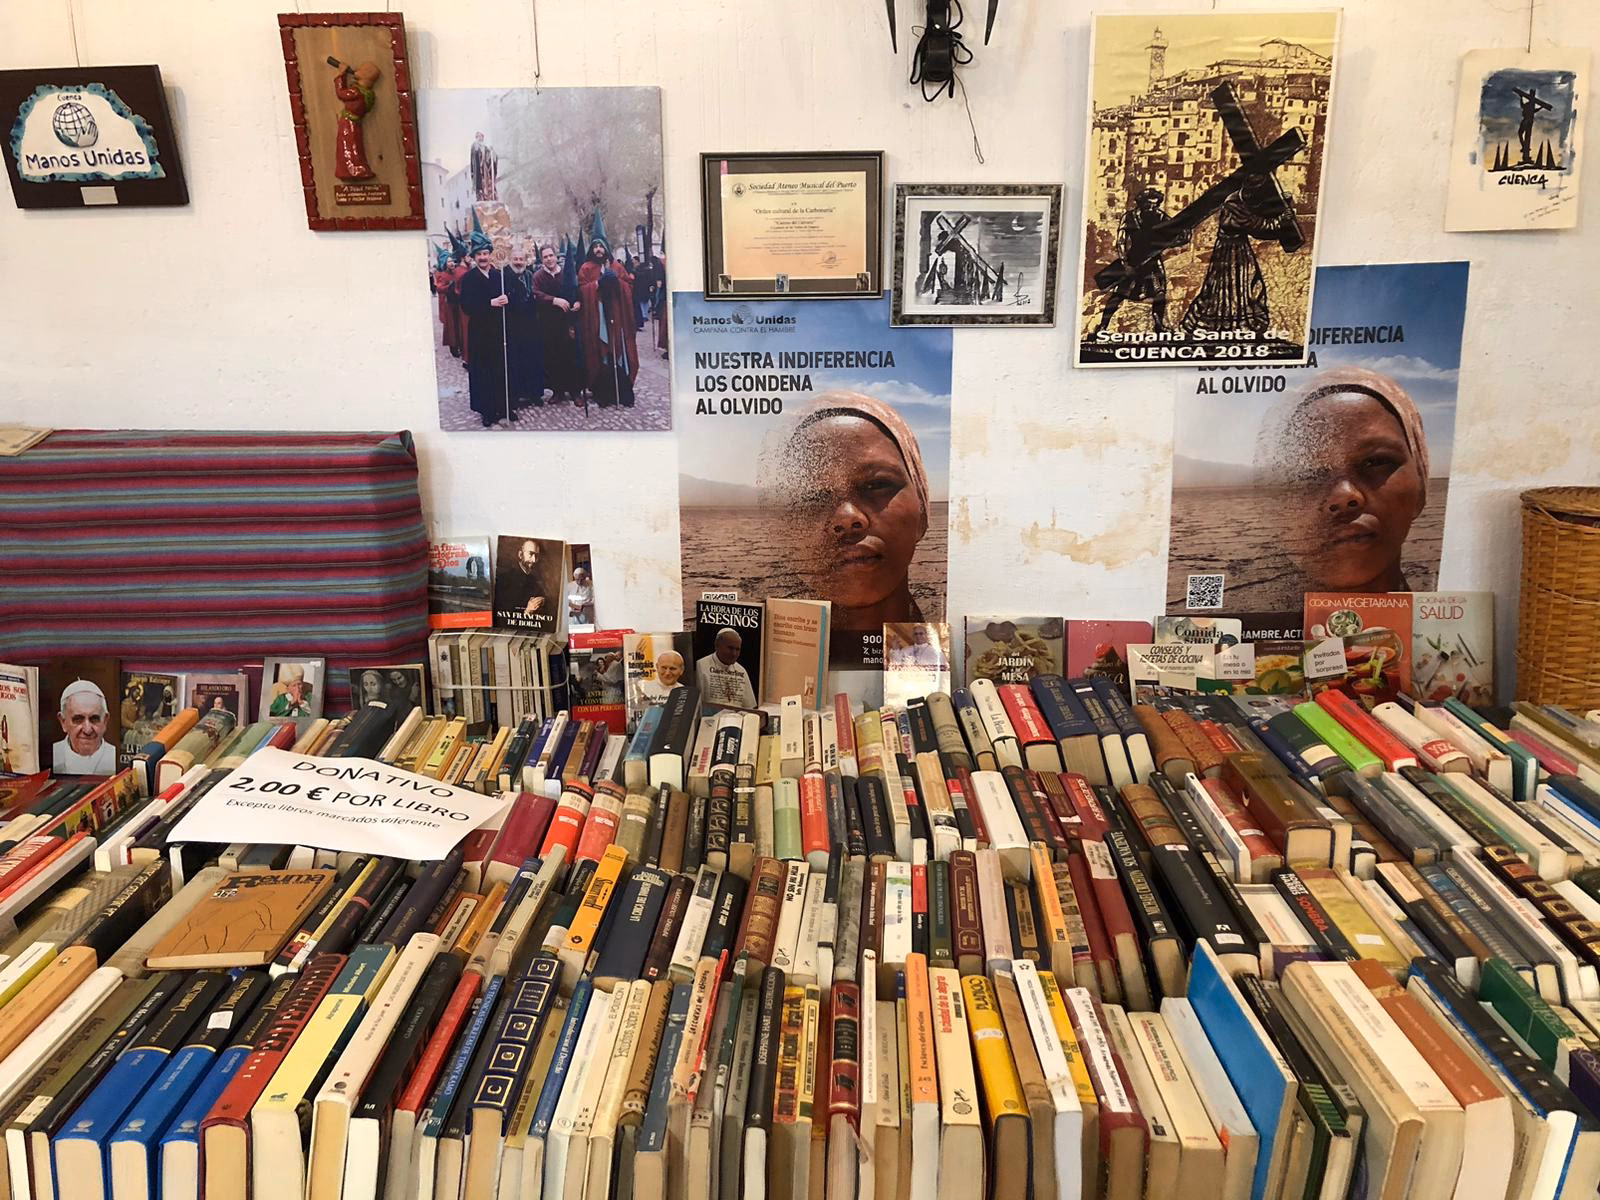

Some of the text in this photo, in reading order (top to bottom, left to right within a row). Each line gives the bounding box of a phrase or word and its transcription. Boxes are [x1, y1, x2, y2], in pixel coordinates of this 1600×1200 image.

[58, 94, 82, 102] Cuenca
[26, 148, 144, 171] Manos Unidas
[776, 182, 798, 190] Ateneo
[1498, 174, 1548, 189] CUENCA
[693, 316, 796, 326] Manos Unidas
[730, 326, 758, 334] CONTRA
[1096, 328, 1290, 344] Semana Santa de
[1308, 325, 1404, 345] DIFERENCIA
[696, 351, 896, 369] NUESTRA INDIFERENCIA
[1115, 345, 1270, 360] CUENCA 2018
[696, 375, 814, 392] LOS CONDENA
[1197, 375, 1286, 394] AL OLVIDO
[696, 398, 782, 414] AL OLVIDO
[700, 604, 758, 616] LA HORA DE LOS
[1310, 598, 1410, 608] COCINA VEGETARIANA
[496, 610, 553, 622] SAN FRANCISCO
[1419, 605, 1464, 620] SALUD
[507, 618, 542, 628] DE BORJA
[700, 612, 759, 629] ASESINOS
[1175, 624, 1224, 638] Comida
[1284, 630, 1302, 639] ACT
[863, 635, 882, 644] 900
[1150, 646, 1192, 654] CONSEJOS Y
[1313, 652, 1341, 660] Invitados
[1140, 654, 1204, 664] RECETAS DE COCINA
[1314, 660, 1325, 668] por
[1002, 672, 1029, 682] MESA
[1316, 665, 1344, 674] sorpresa
[292, 761, 453, 798] DONATIVO
[230, 777, 470, 822] 2,00 € POR LIBRO
[226, 798, 441, 830] Excepto libros marcados diferente
[223, 874, 326, 889] Reuma
[1280, 874, 1309, 896] ROBERT HARRIS
[490, 979, 500, 991] LAS
[614, 1029, 634, 1059] Estudios
[626, 1011, 639, 1030] sobre
[758, 1032, 770, 1066] JOSEPHINE
[764, 1014, 772, 1032] HART
[452, 1056, 466, 1075] TONY
[554, 1052, 567, 1074] Derecho
